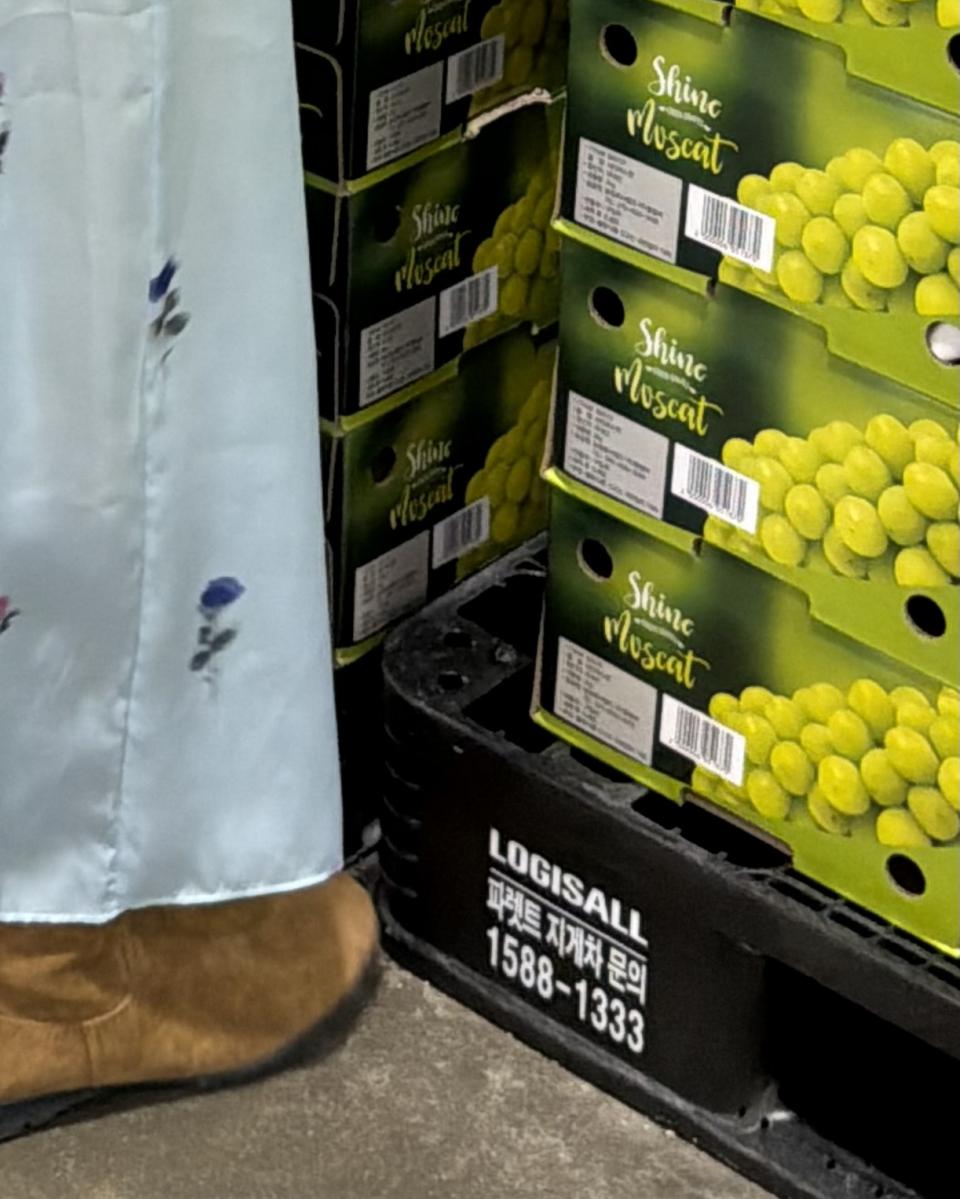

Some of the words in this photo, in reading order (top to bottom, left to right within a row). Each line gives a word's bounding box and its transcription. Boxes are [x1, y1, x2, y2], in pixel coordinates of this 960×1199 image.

[647, 55, 723, 119] Shine
[627, 99, 739, 175] Moscat
[411, 203, 460, 242] Shine
[395, 230, 471, 293] Moscat
[634, 317, 709, 383] Shine
[613, 359, 724, 436] Moscat
[406, 438, 452, 477] Shine
[390, 465, 463, 531] Moscat
[624, 571, 696, 638] Shine
[603, 611, 711, 689] Moscat
[490, 827, 648, 947] LOGISALL
[487, 926, 644, 1053] 1588-1333
[546, 913, 603, 979] 지게차
[608, 947, 647, 1006] 문의
